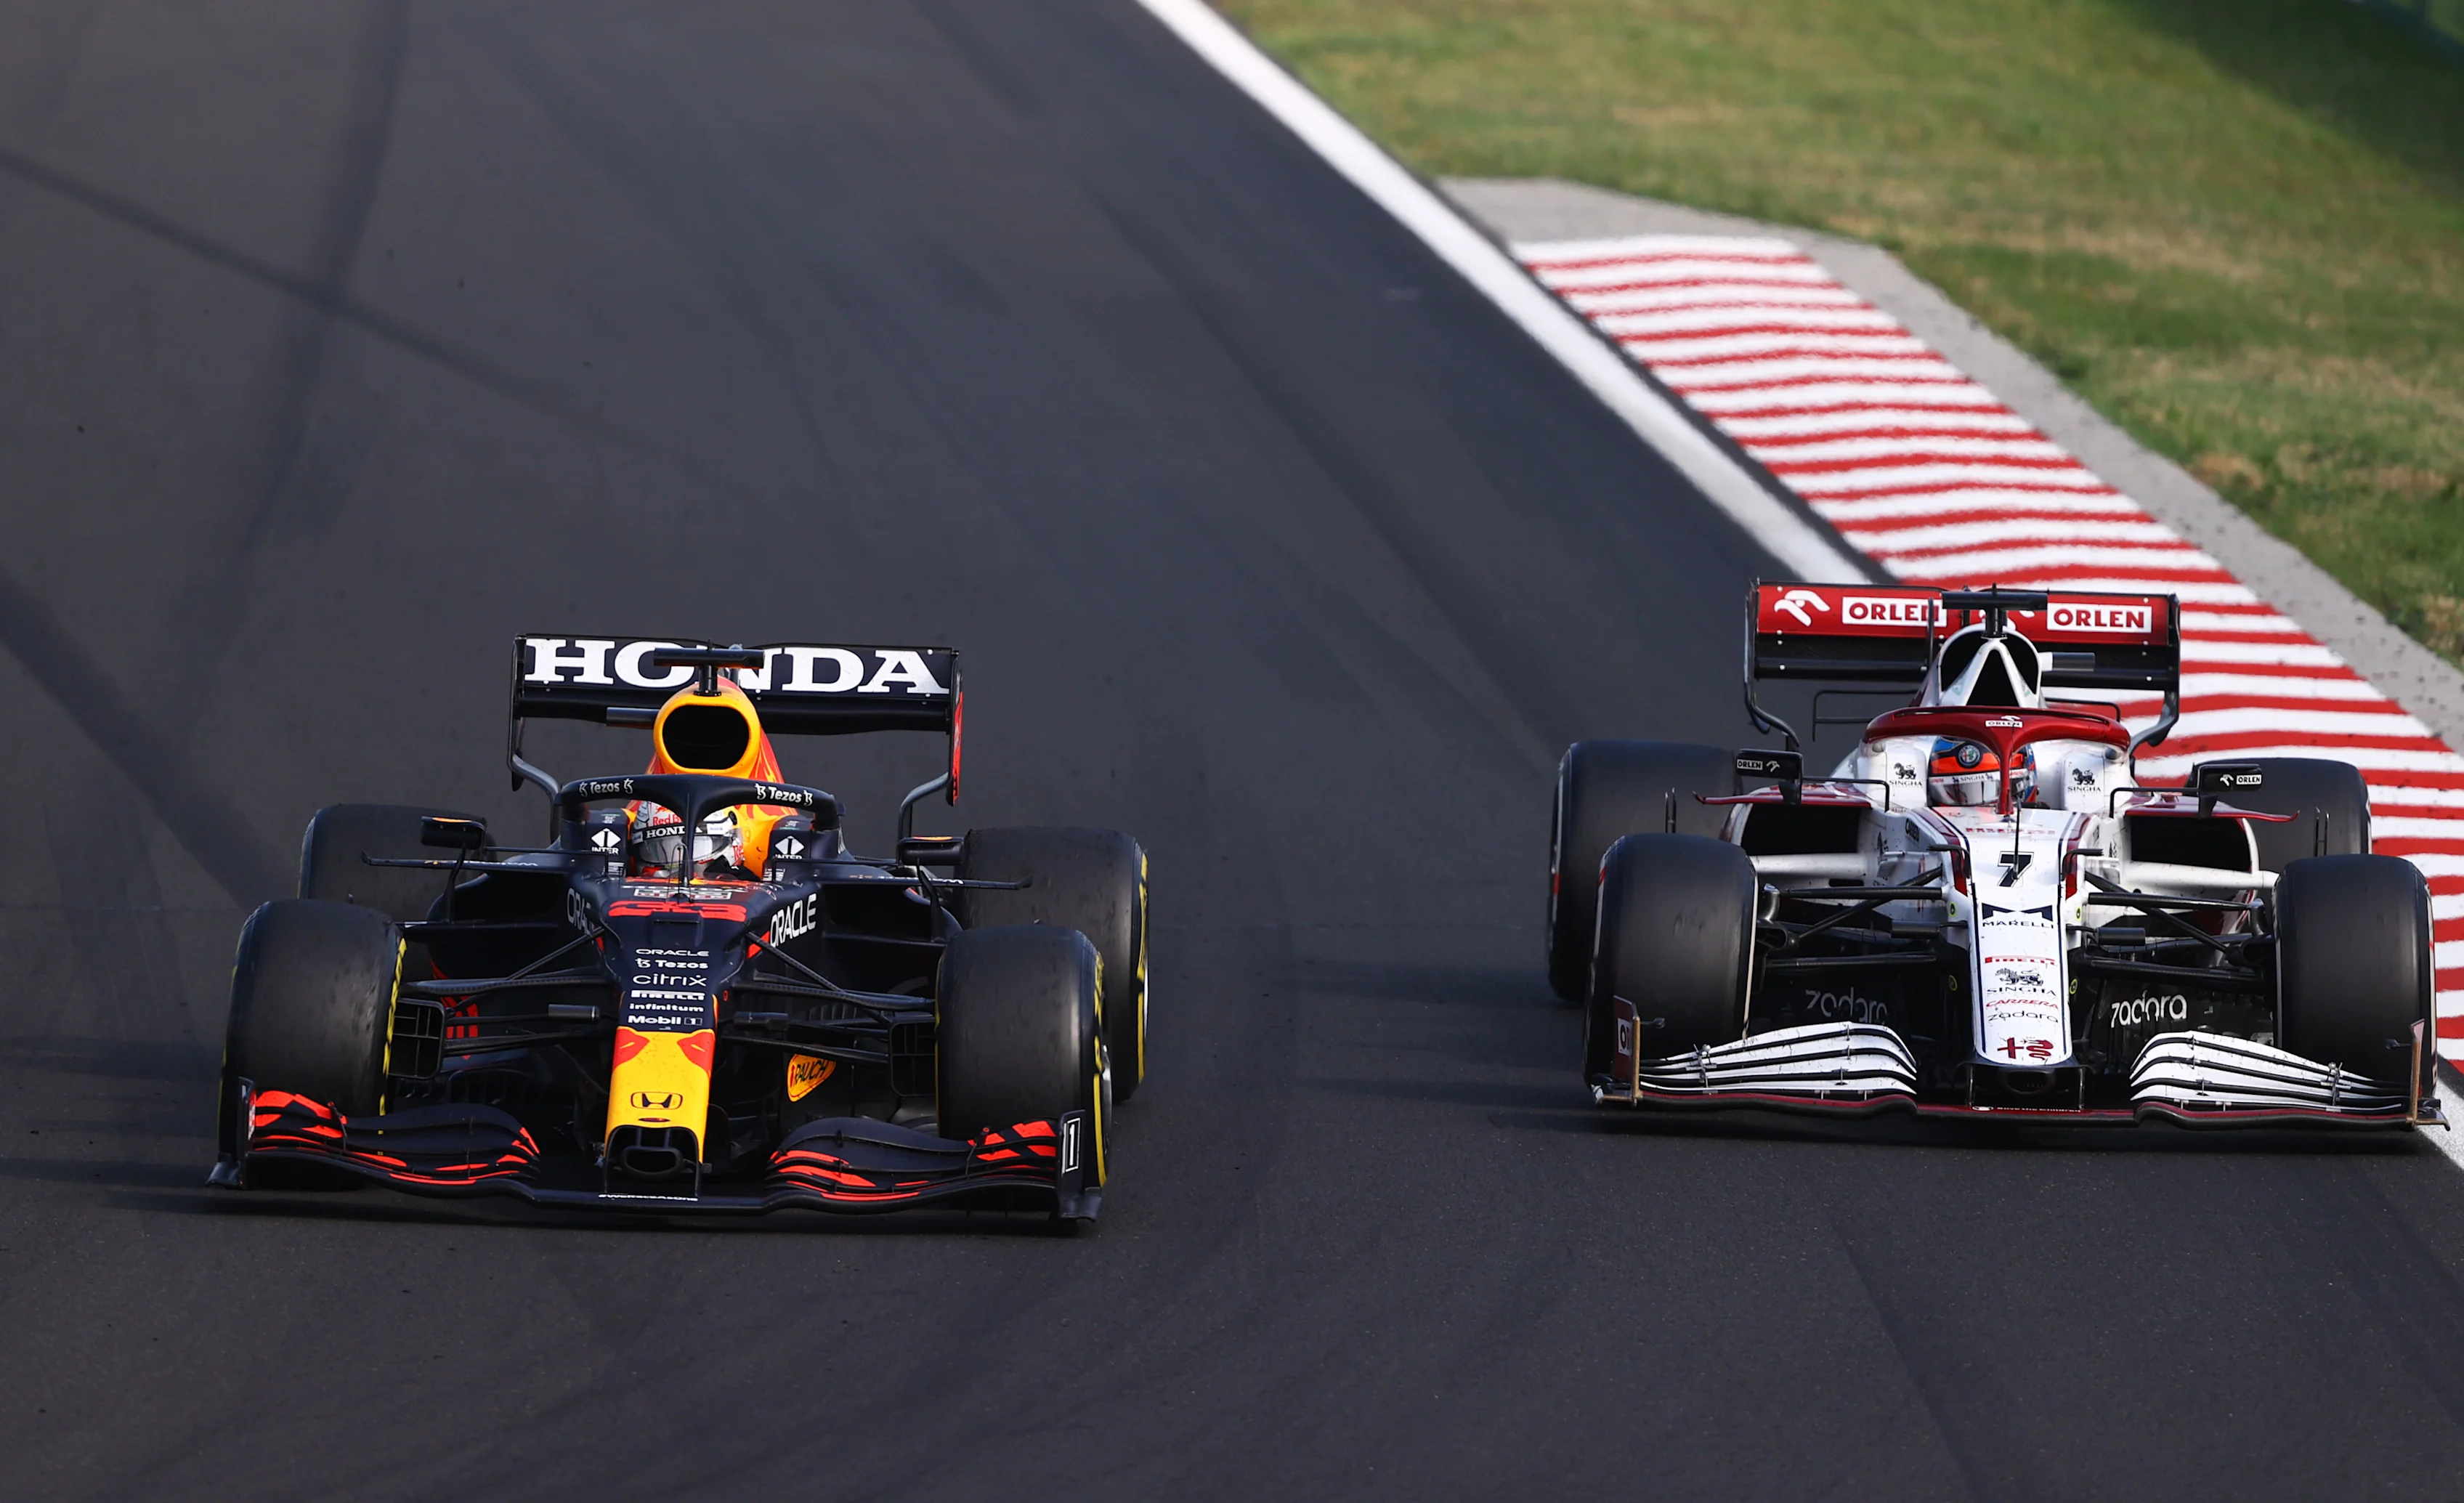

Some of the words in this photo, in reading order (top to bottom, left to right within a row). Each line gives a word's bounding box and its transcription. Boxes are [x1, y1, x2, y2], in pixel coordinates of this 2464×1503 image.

[2054, 609, 2144, 628] ORLEN
[1738, 760, 1762, 769] ORLEN
[590, 781, 620, 794] Tezos
[768, 786, 803, 803] Tezos
[591, 846, 619, 855] INTER
[1998, 851, 2034, 888] 7
[770, 893, 817, 948] ORACLE
[1982, 920, 2054, 929] MARELLI
[654, 960, 709, 969] Tezos
[631, 990, 705, 1000] PIRELLI
[1987, 987, 2056, 997] SINGHA
[629, 1003, 704, 1012] infinitum
[1986, 999, 2059, 1010] CARRERA
[628, 1016, 681, 1025] Mobil
